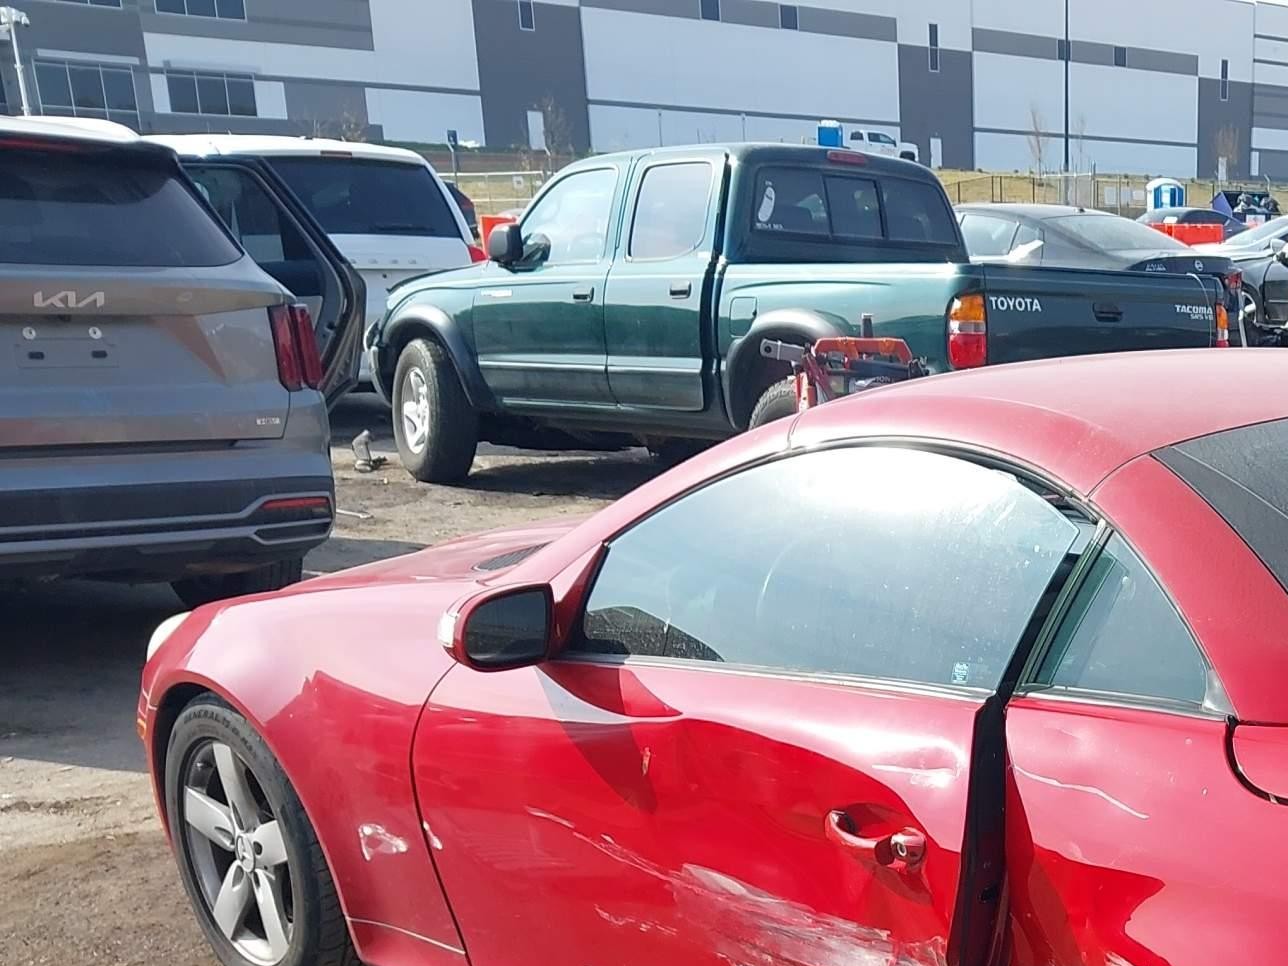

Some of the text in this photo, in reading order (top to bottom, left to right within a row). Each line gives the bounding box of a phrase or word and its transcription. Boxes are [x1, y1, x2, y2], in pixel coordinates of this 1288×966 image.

[33, 290, 105, 308] KIA
[990, 296, 1042, 312] TOYOTA
[1175, 304, 1213, 315] TACOMA
